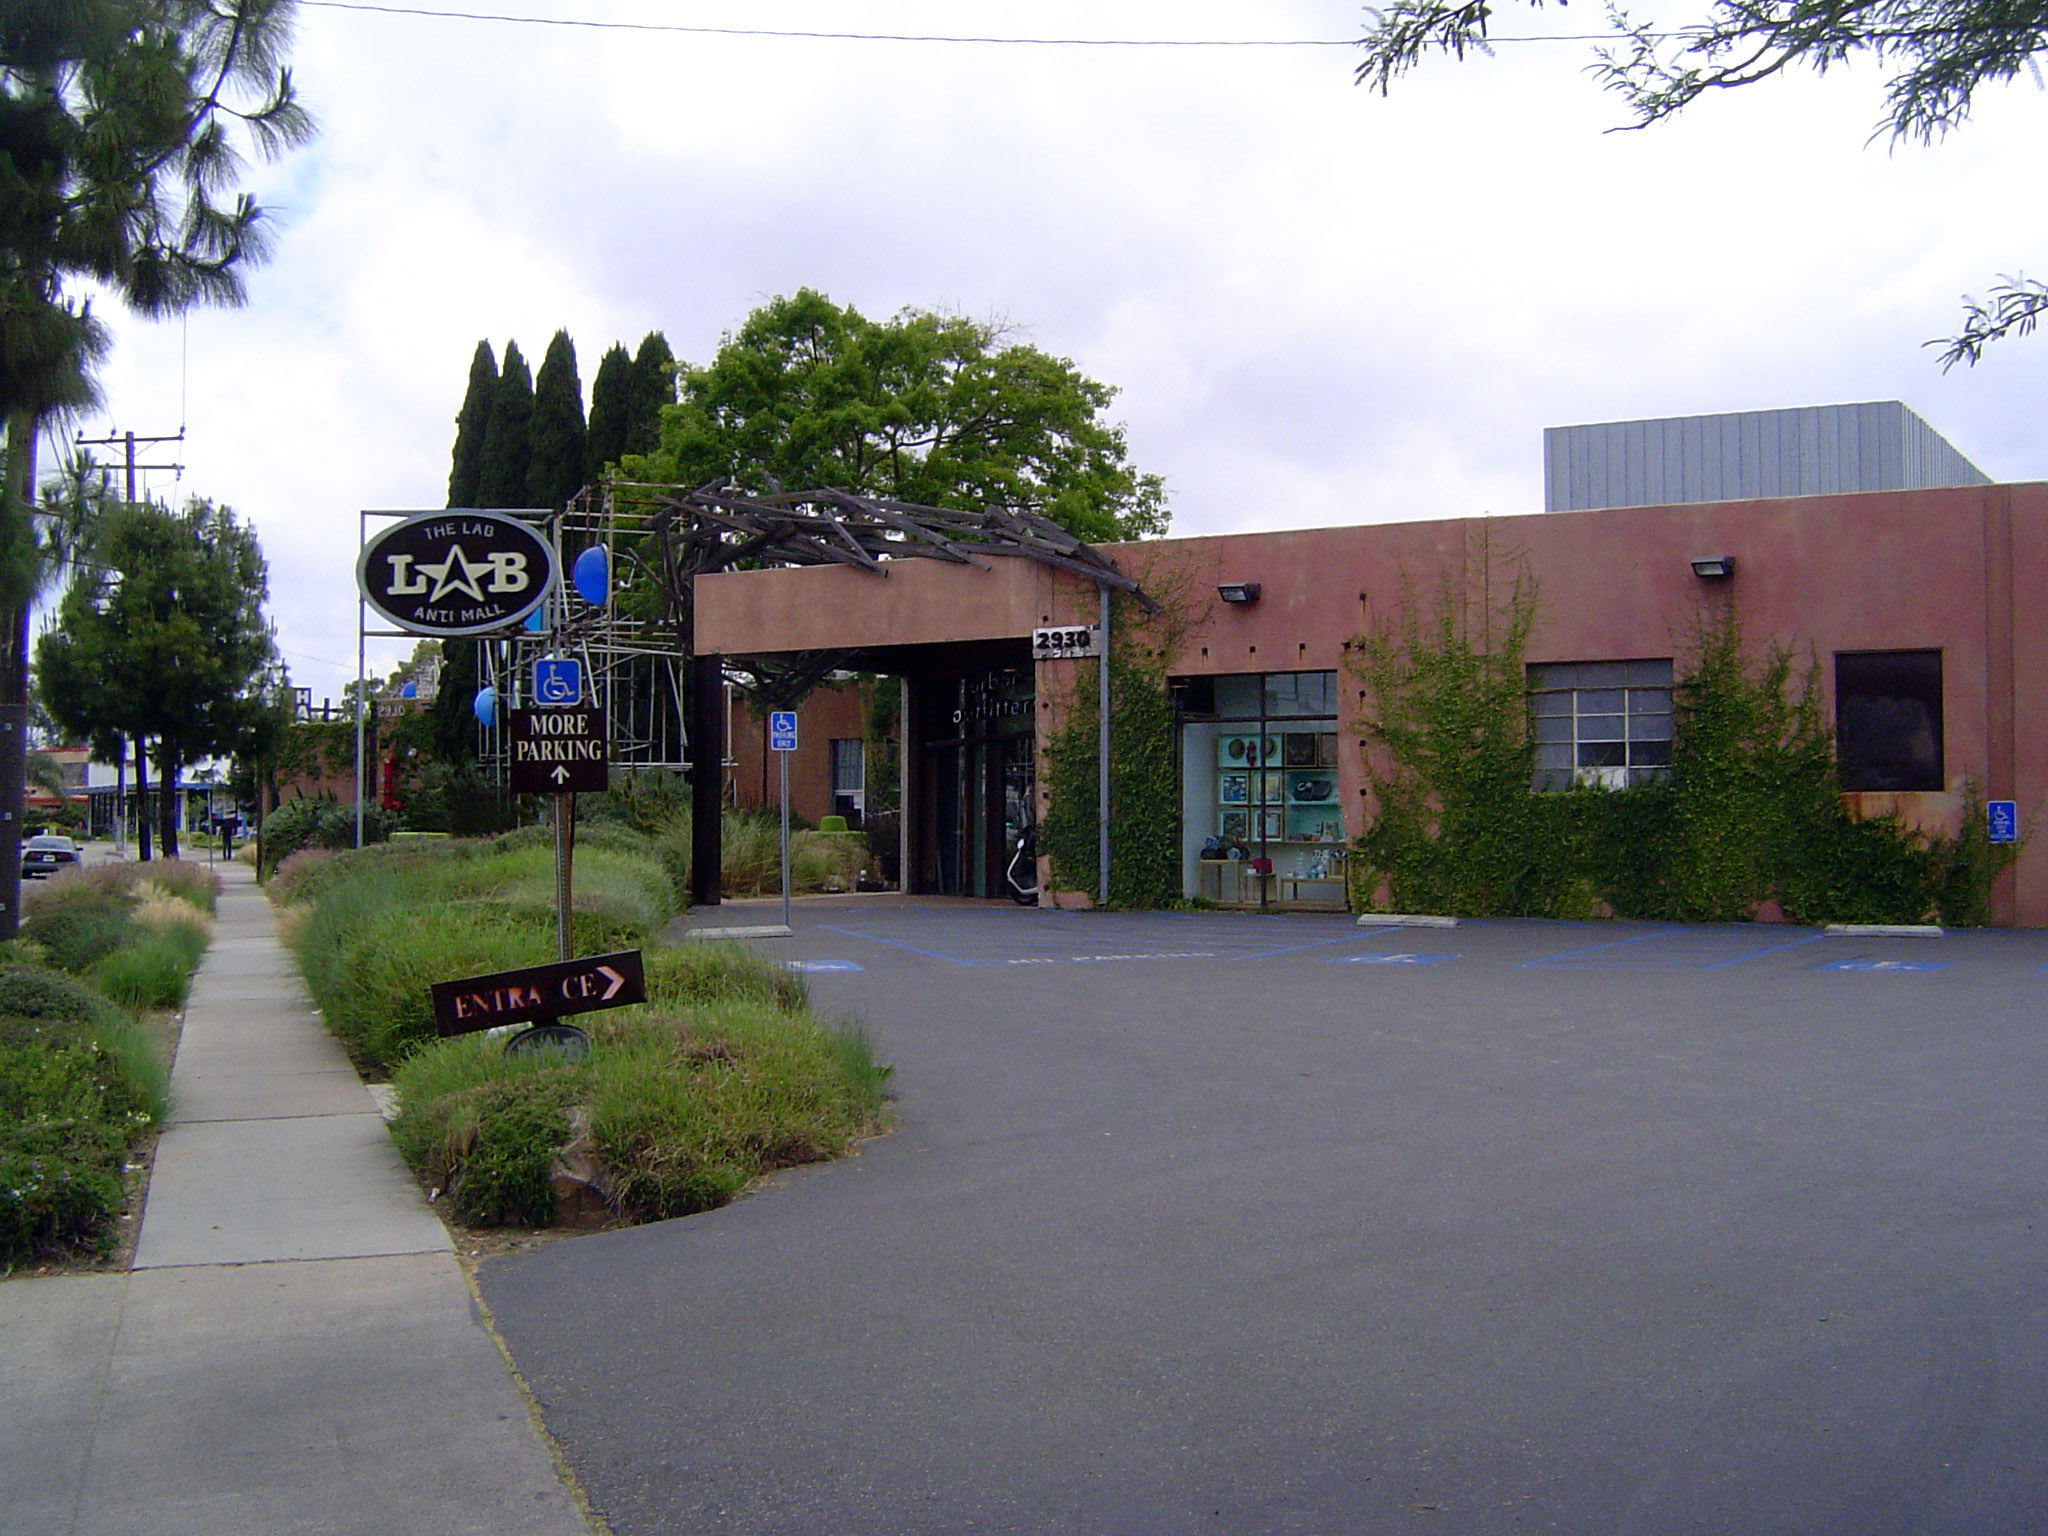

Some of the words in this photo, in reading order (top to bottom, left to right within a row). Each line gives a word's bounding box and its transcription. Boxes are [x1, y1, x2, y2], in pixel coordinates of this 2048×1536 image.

[424, 522, 456, 540] THE
[462, 521, 495, 538] LAB
[386, 544, 530, 603] LAB
[414, 606, 454, 623] ANTI
[461, 603, 505, 623] MALL
[1036, 630, 1091, 650] 2930
[296, 690, 310, 724] HA
[530, 713, 589, 735] MORE
[516, 740, 602, 762] PARKING
[455, 973, 598, 1019] ENTRACE
